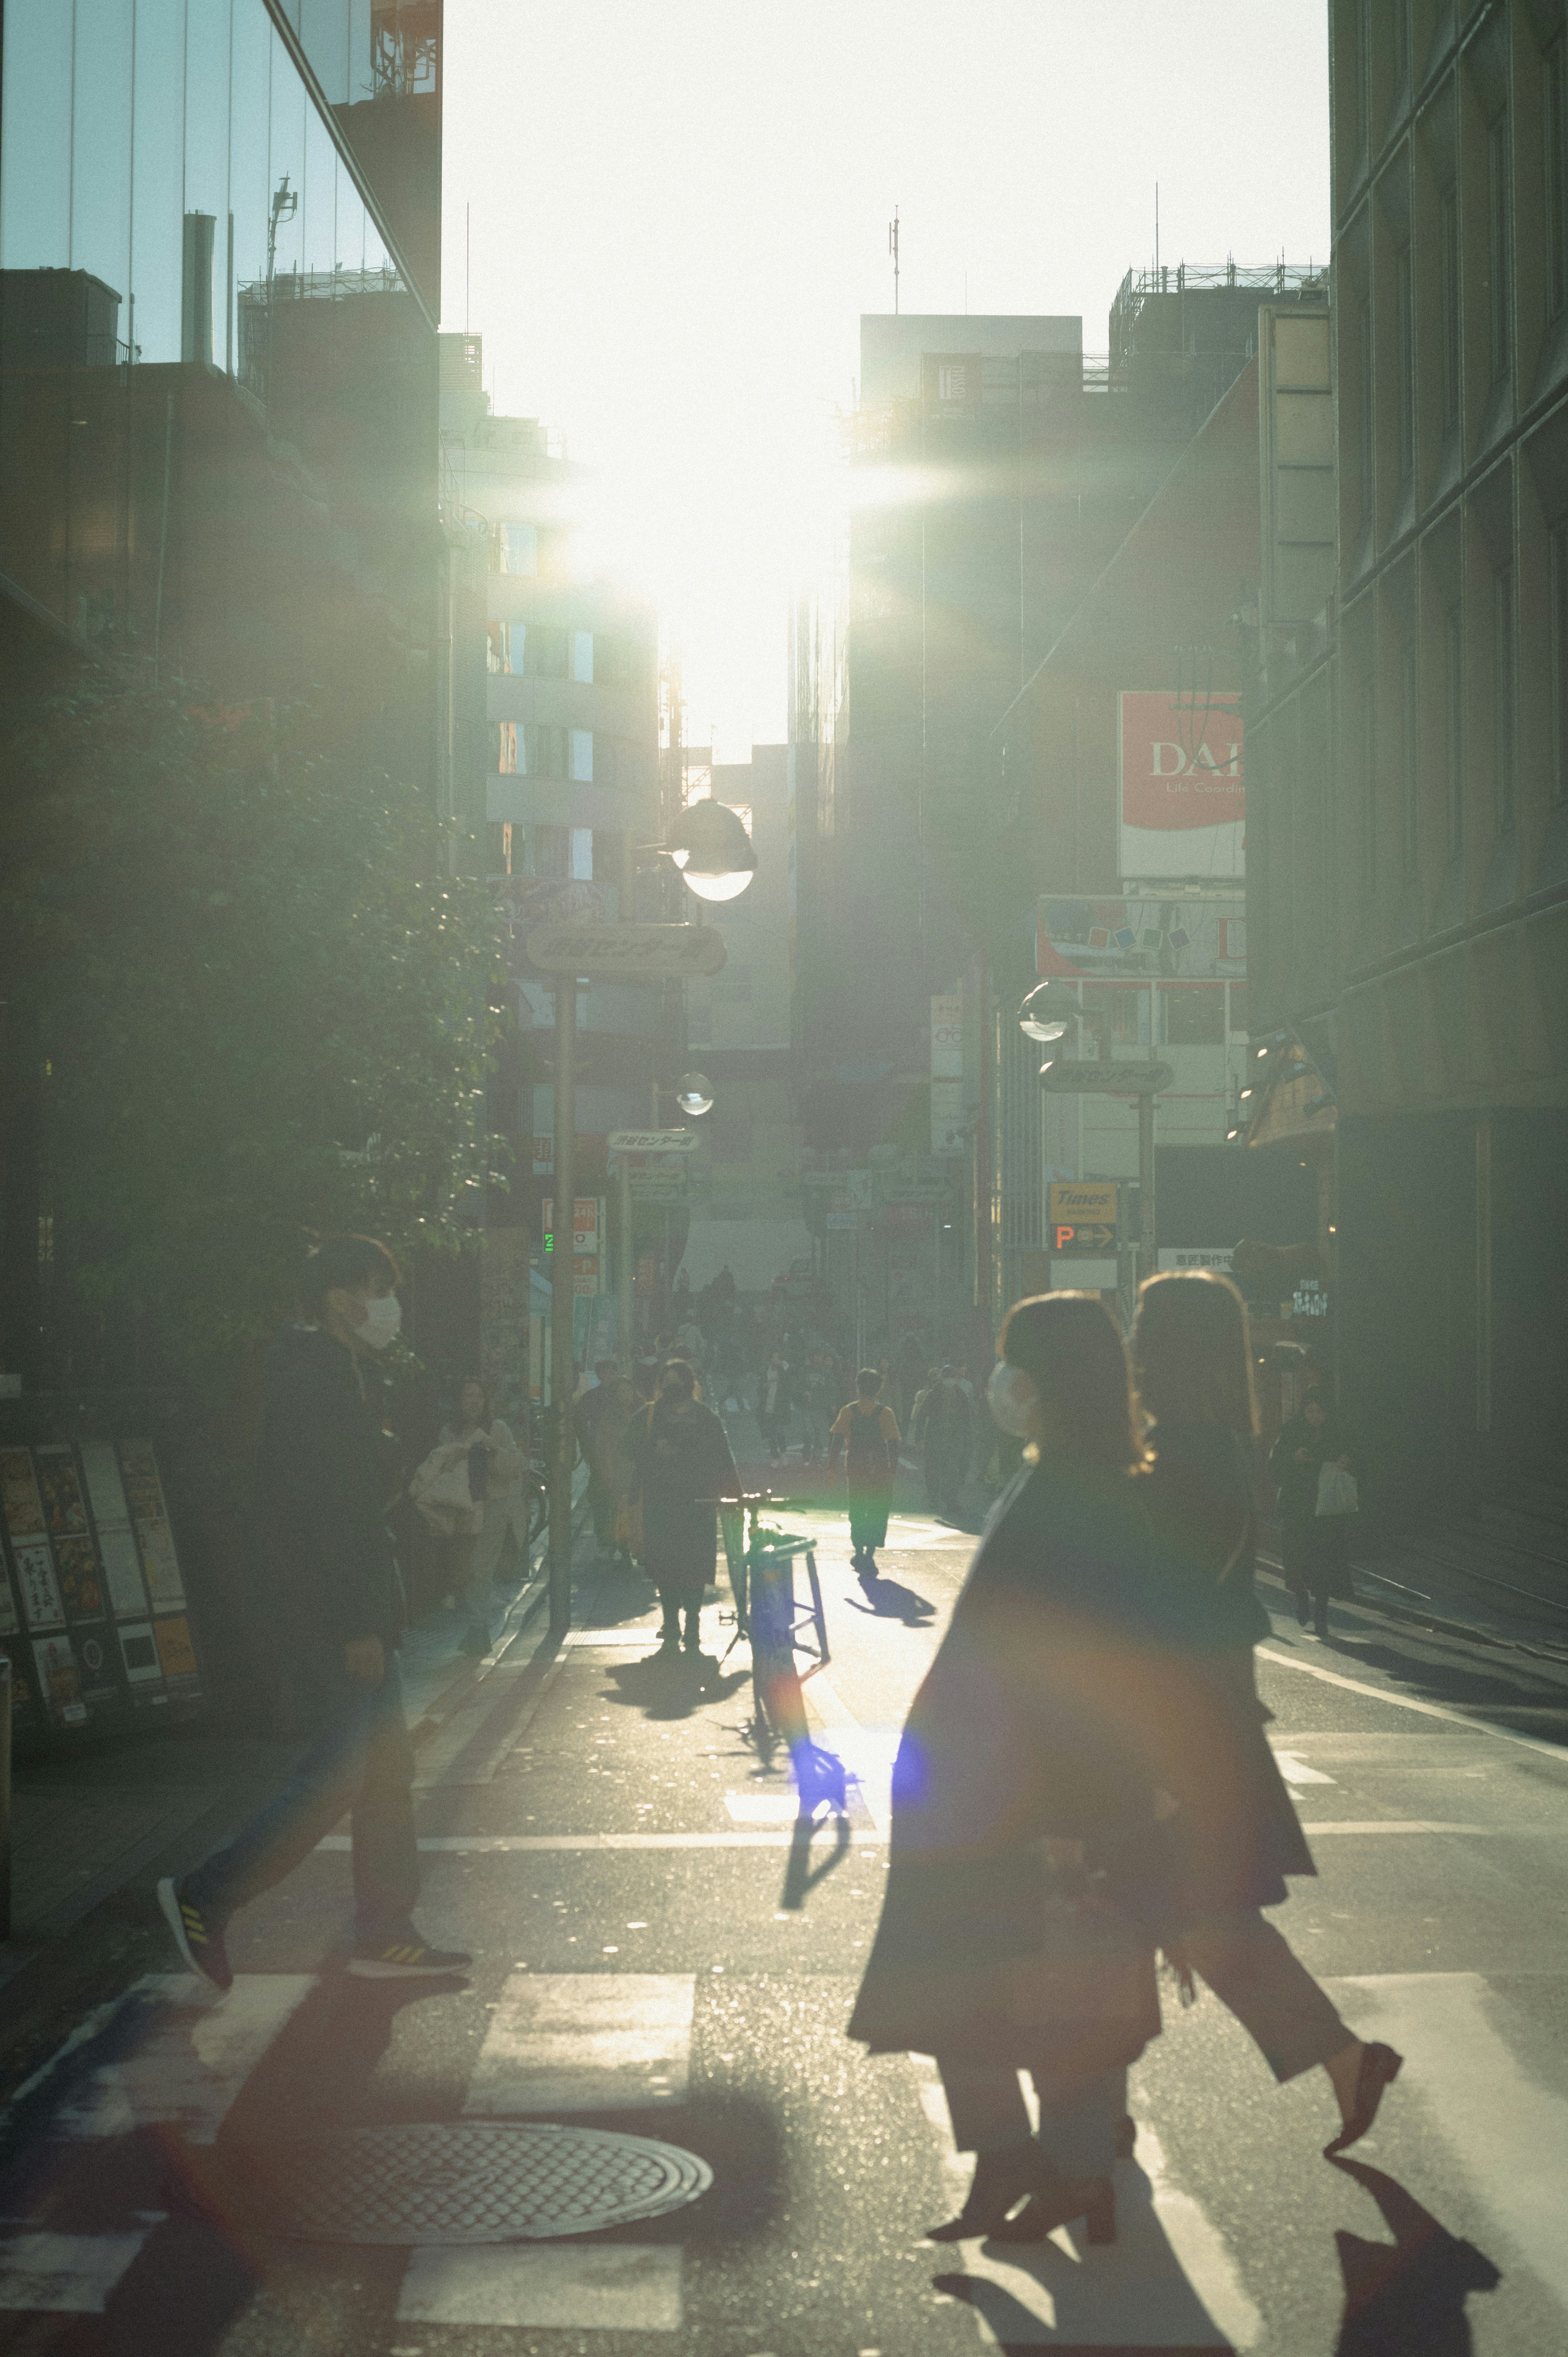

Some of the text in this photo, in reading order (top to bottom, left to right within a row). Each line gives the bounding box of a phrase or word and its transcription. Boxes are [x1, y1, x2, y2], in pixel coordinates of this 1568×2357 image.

[1150, 742, 1241, 776] DAI
[1166, 782, 1190, 792] Life
[614, 1135, 694, 1146] 渋谷センター街
[1058, 1190, 1109, 1205] Times
[1056, 1226, 1074, 1249] P
